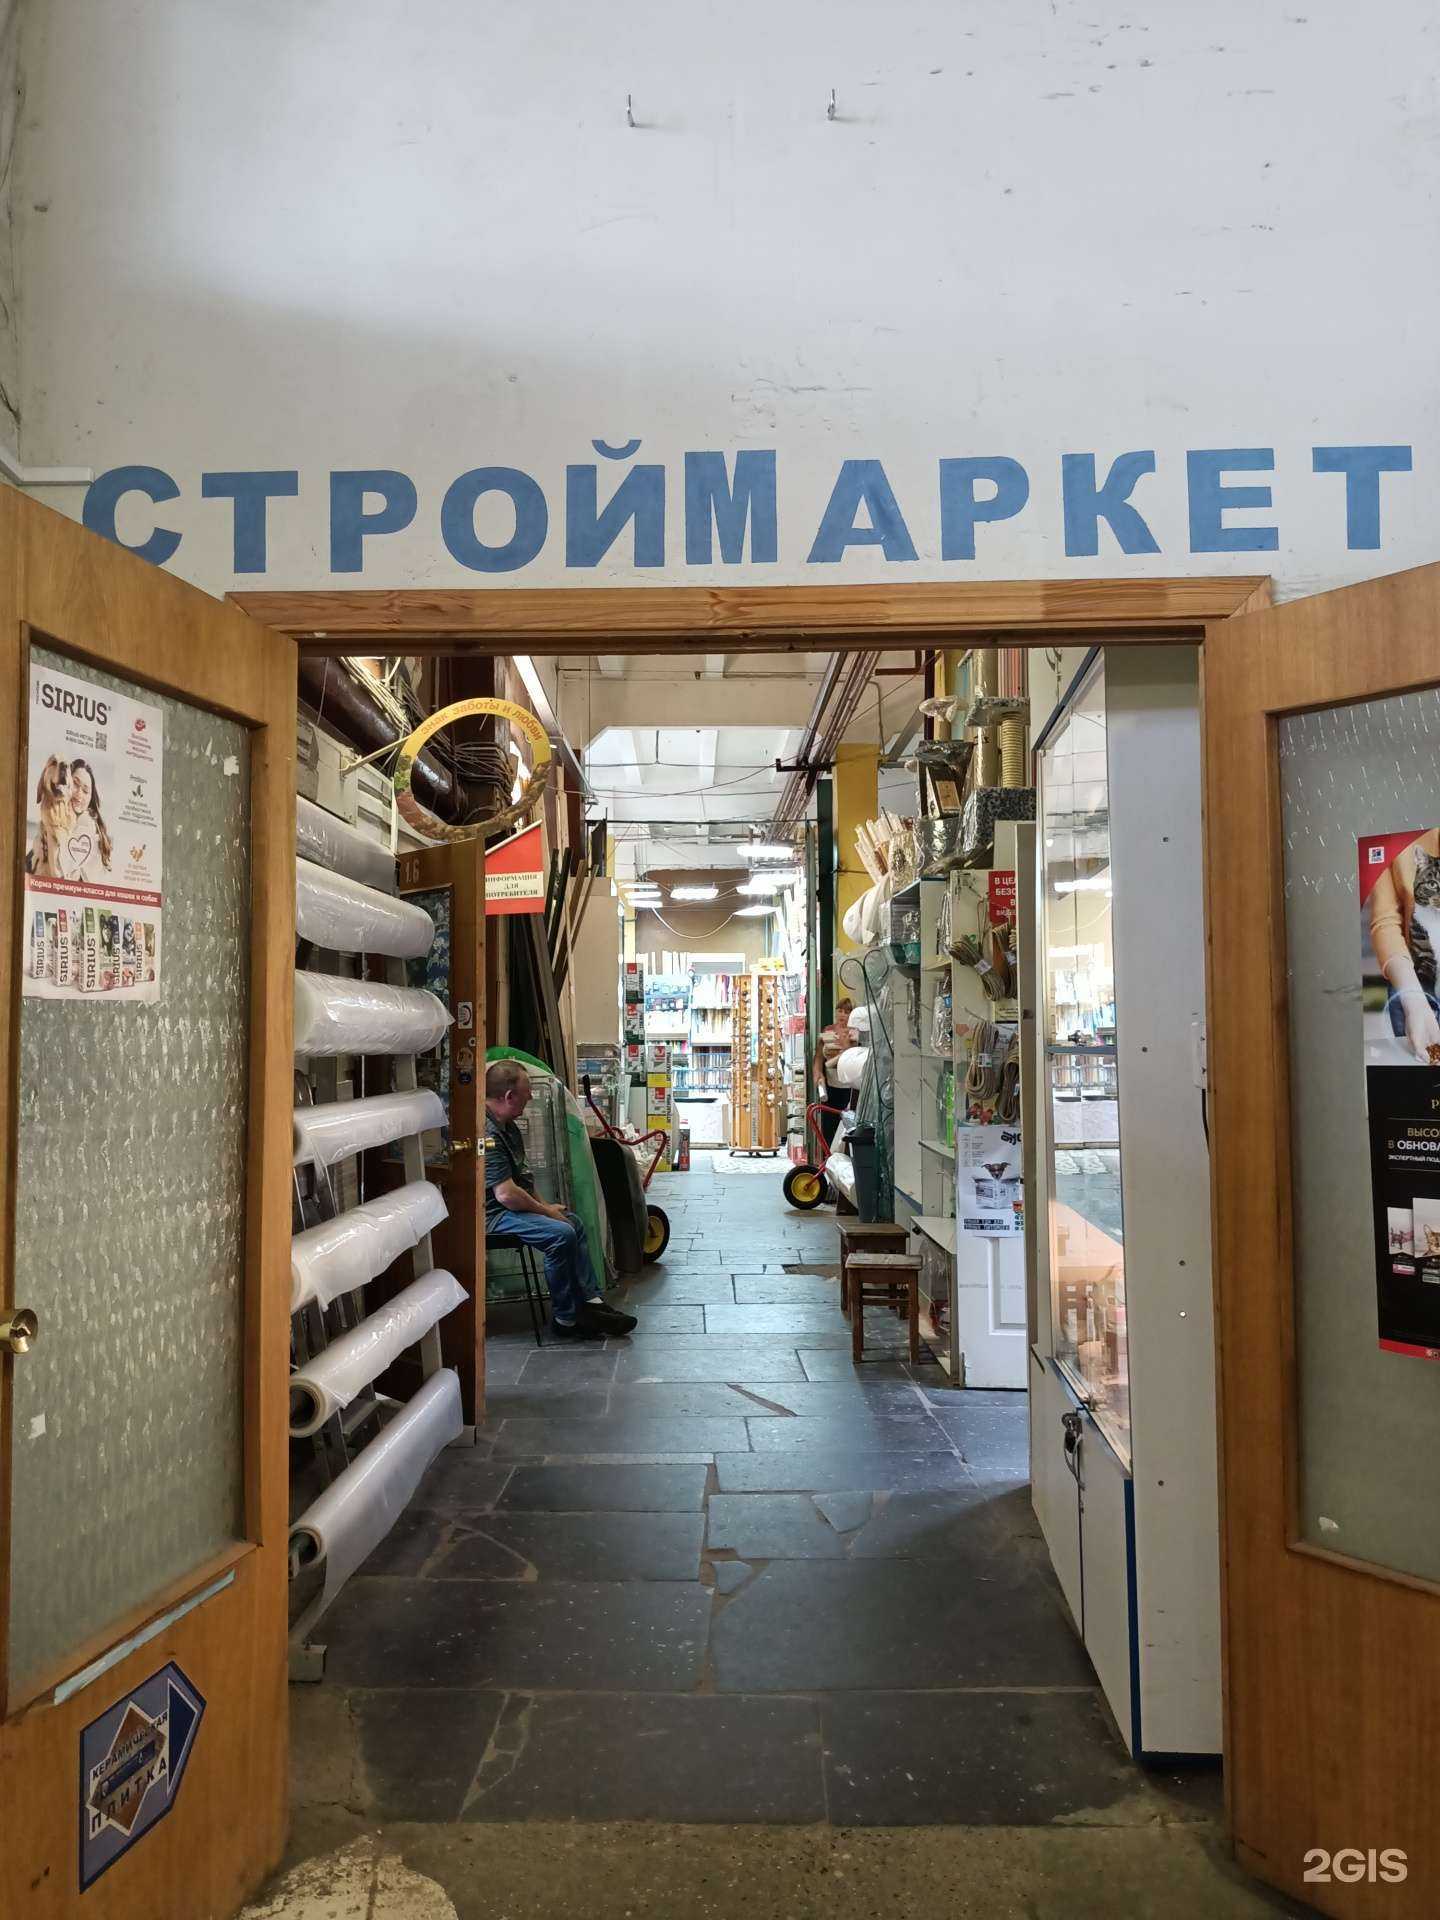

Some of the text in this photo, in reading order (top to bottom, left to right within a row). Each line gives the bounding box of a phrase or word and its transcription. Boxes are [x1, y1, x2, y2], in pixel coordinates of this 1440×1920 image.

[83, 439, 1413, 573] СТРОЙМАРКЕТ
[41, 683, 108, 726] SIRIUS
[1002, 877, 1016, 886] ЦЕ
[36, 940, 45, 976] SIRIUS
[59, 936, 69, 983] SIRIUS
[86, 937, 96, 989] SIRIUS
[113, 947, 121, 985] SIRIUS
[134, 943, 143, 980] SIRIUS
[1387, 1139, 1395, 1149] В
[91, 1757, 168, 1833] ПЛИТКА
